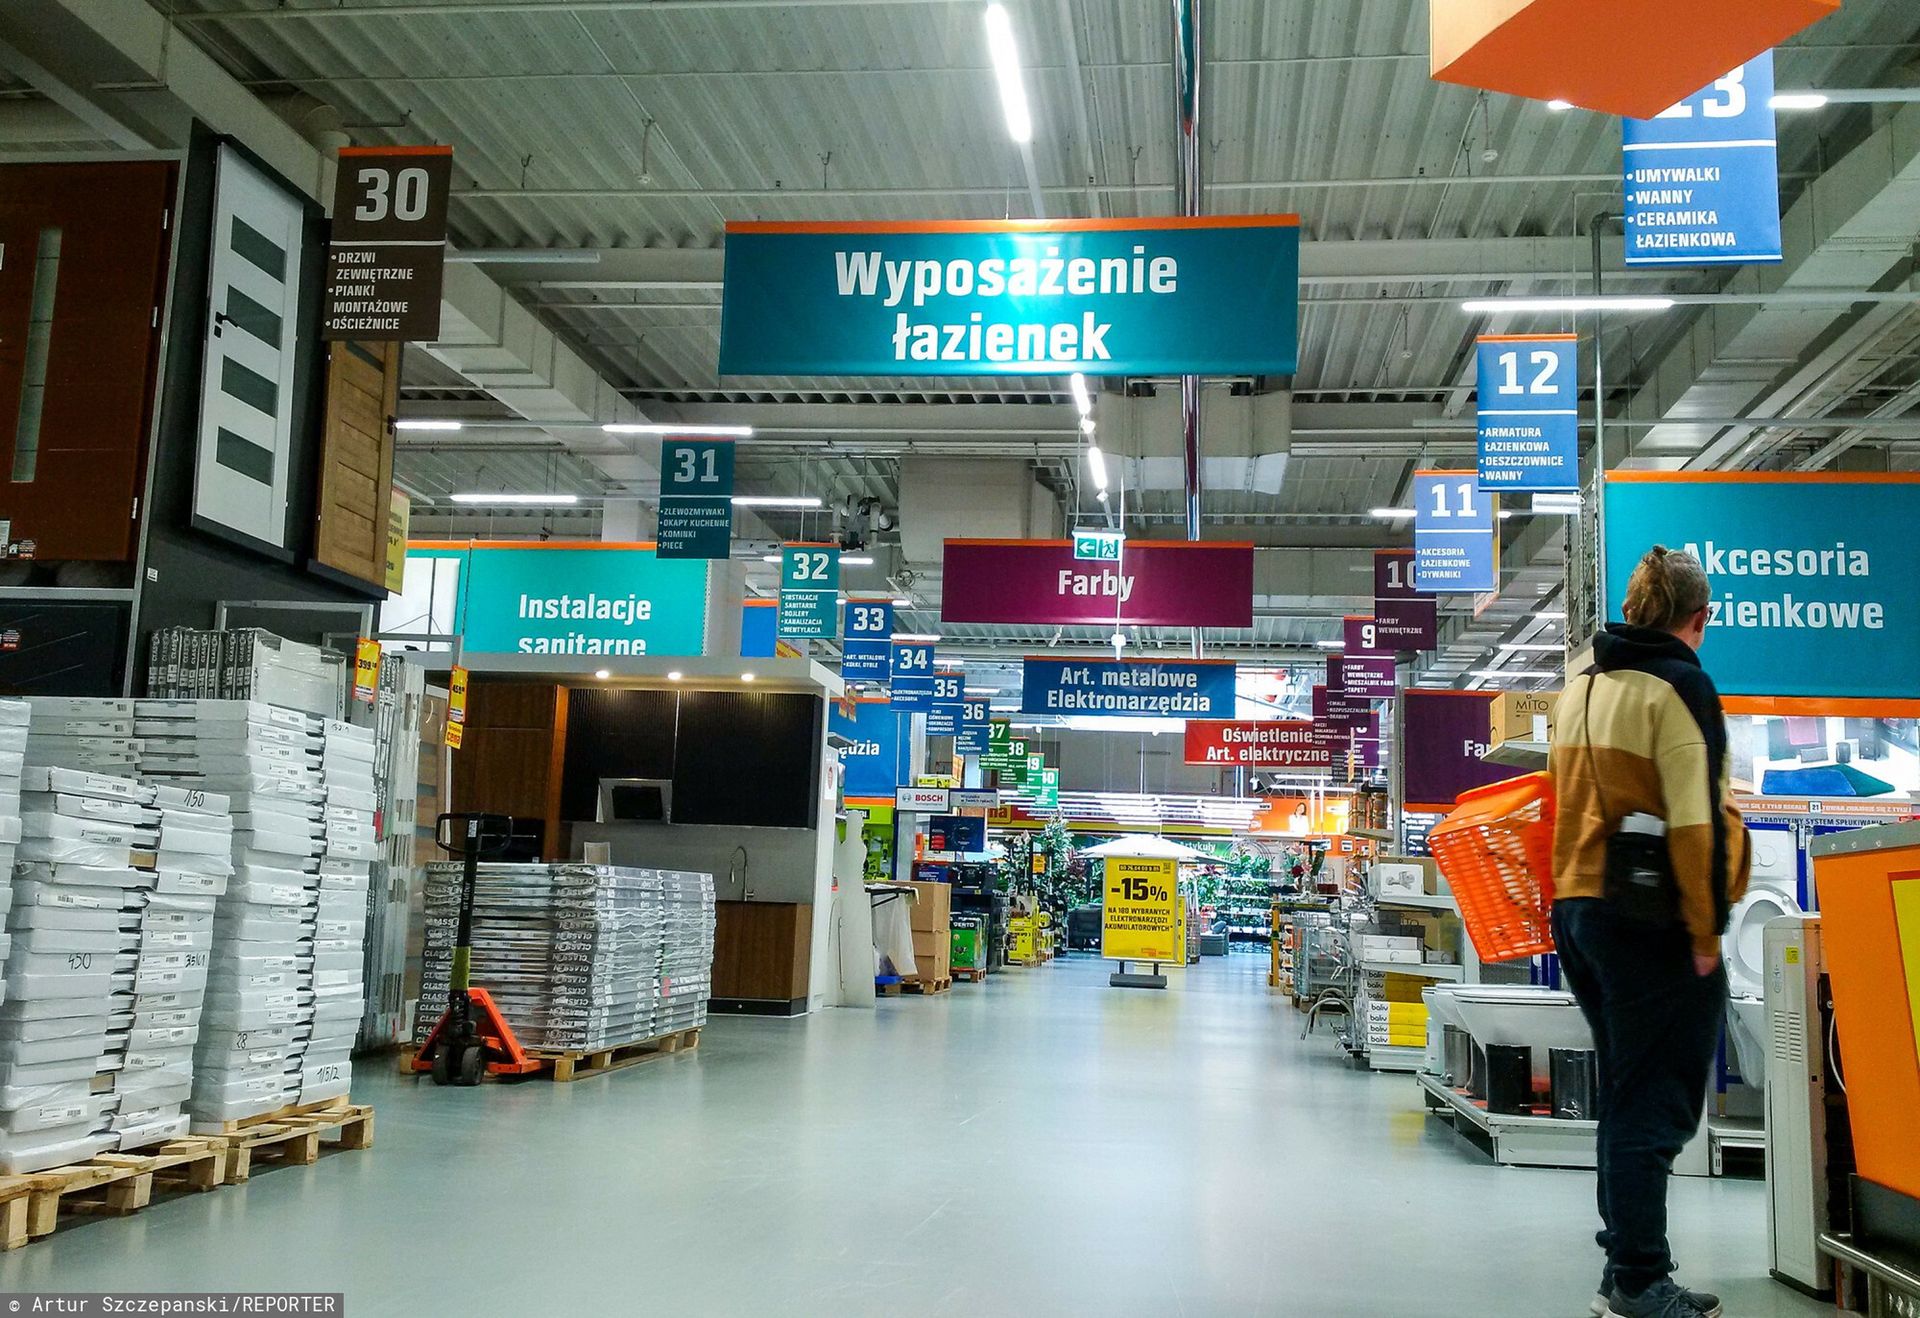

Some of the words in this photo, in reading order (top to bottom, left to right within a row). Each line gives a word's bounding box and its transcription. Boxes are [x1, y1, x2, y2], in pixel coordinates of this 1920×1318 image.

[1655, 64, 1746, 119] 3
[1635, 168, 1720, 184] UMYWALKI
[354, 167, 430, 222] 30
[1635, 190, 1693, 204] WANNY
[1636, 211, 1718, 226] CERAMIKA
[1636, 232, 1736, 248] ŁAZIENKOWA
[337, 252, 376, 264] DRZWI
[335, 268, 414, 283] ZEWNĘTRZNE
[834, 246, 1178, 306] Wyposażenie
[335, 285, 375, 296] PIANKI
[333, 299, 409, 313] MONTAŻOWE
[332, 316, 400, 330] OŚCIEŻNICE
[892, 312, 1112, 361] łazienek
[1498, 351, 1559, 394] 12
[1485, 427, 1541, 437] ARMATURA
[1485, 441, 1550, 452] ŁAZIENKOWA
[674, 448, 719, 482] 31
[1485, 456, 1564, 466] DESZCZOWNICE
[1485, 470, 1523, 480] WANNY
[1431, 483, 1478, 517] 11
[663, 519, 687, 527] OKAPY
[690, 519, 729, 527] KUCHENNE
[662, 530, 696, 538] KOMINKI
[662, 541, 683, 549] PIECE
[1421, 548, 1465, 556] AKCESORIA
[793, 553, 829, 580] 32
[1421, 560, 1471, 568] ŁAZIENKOWE
[1683, 541, 1869, 576] Akcesoria
[1058, 569, 1135, 602] Farby
[519, 593, 652, 626] Instalacje
[1706, 593, 1884, 629] zienkowe
[853, 607, 885, 631] 33
[518, 632, 647, 656] sanitarne
[1361, 624, 1376, 648] 9
[900, 649, 928, 669] 34
[1060, 667, 1096, 687] Art.
[1102, 668, 1197, 688] metalowe
[934, 679, 958, 697] 35
[1047, 690, 1211, 715] Elektronarzędzia
[1516, 700, 1549, 711] MITO
[963, 704, 984, 720] 36
[988, 724, 1006, 738] 37
[1222, 727, 1314, 743] Oświetlenie
[1009, 742, 1024, 755] 38
[1206, 746, 1235, 761] Art.
[1240, 746, 1330, 764] elektryczne
[184, 789, 205, 807] 150
[1806, 818, 1834, 826] SYSTEM
[1111, 878, 1168, 901] -15%
[1110, 915, 1168, 924] ELEKTRONARZĘDZI
[68, 952, 92, 970] 450
